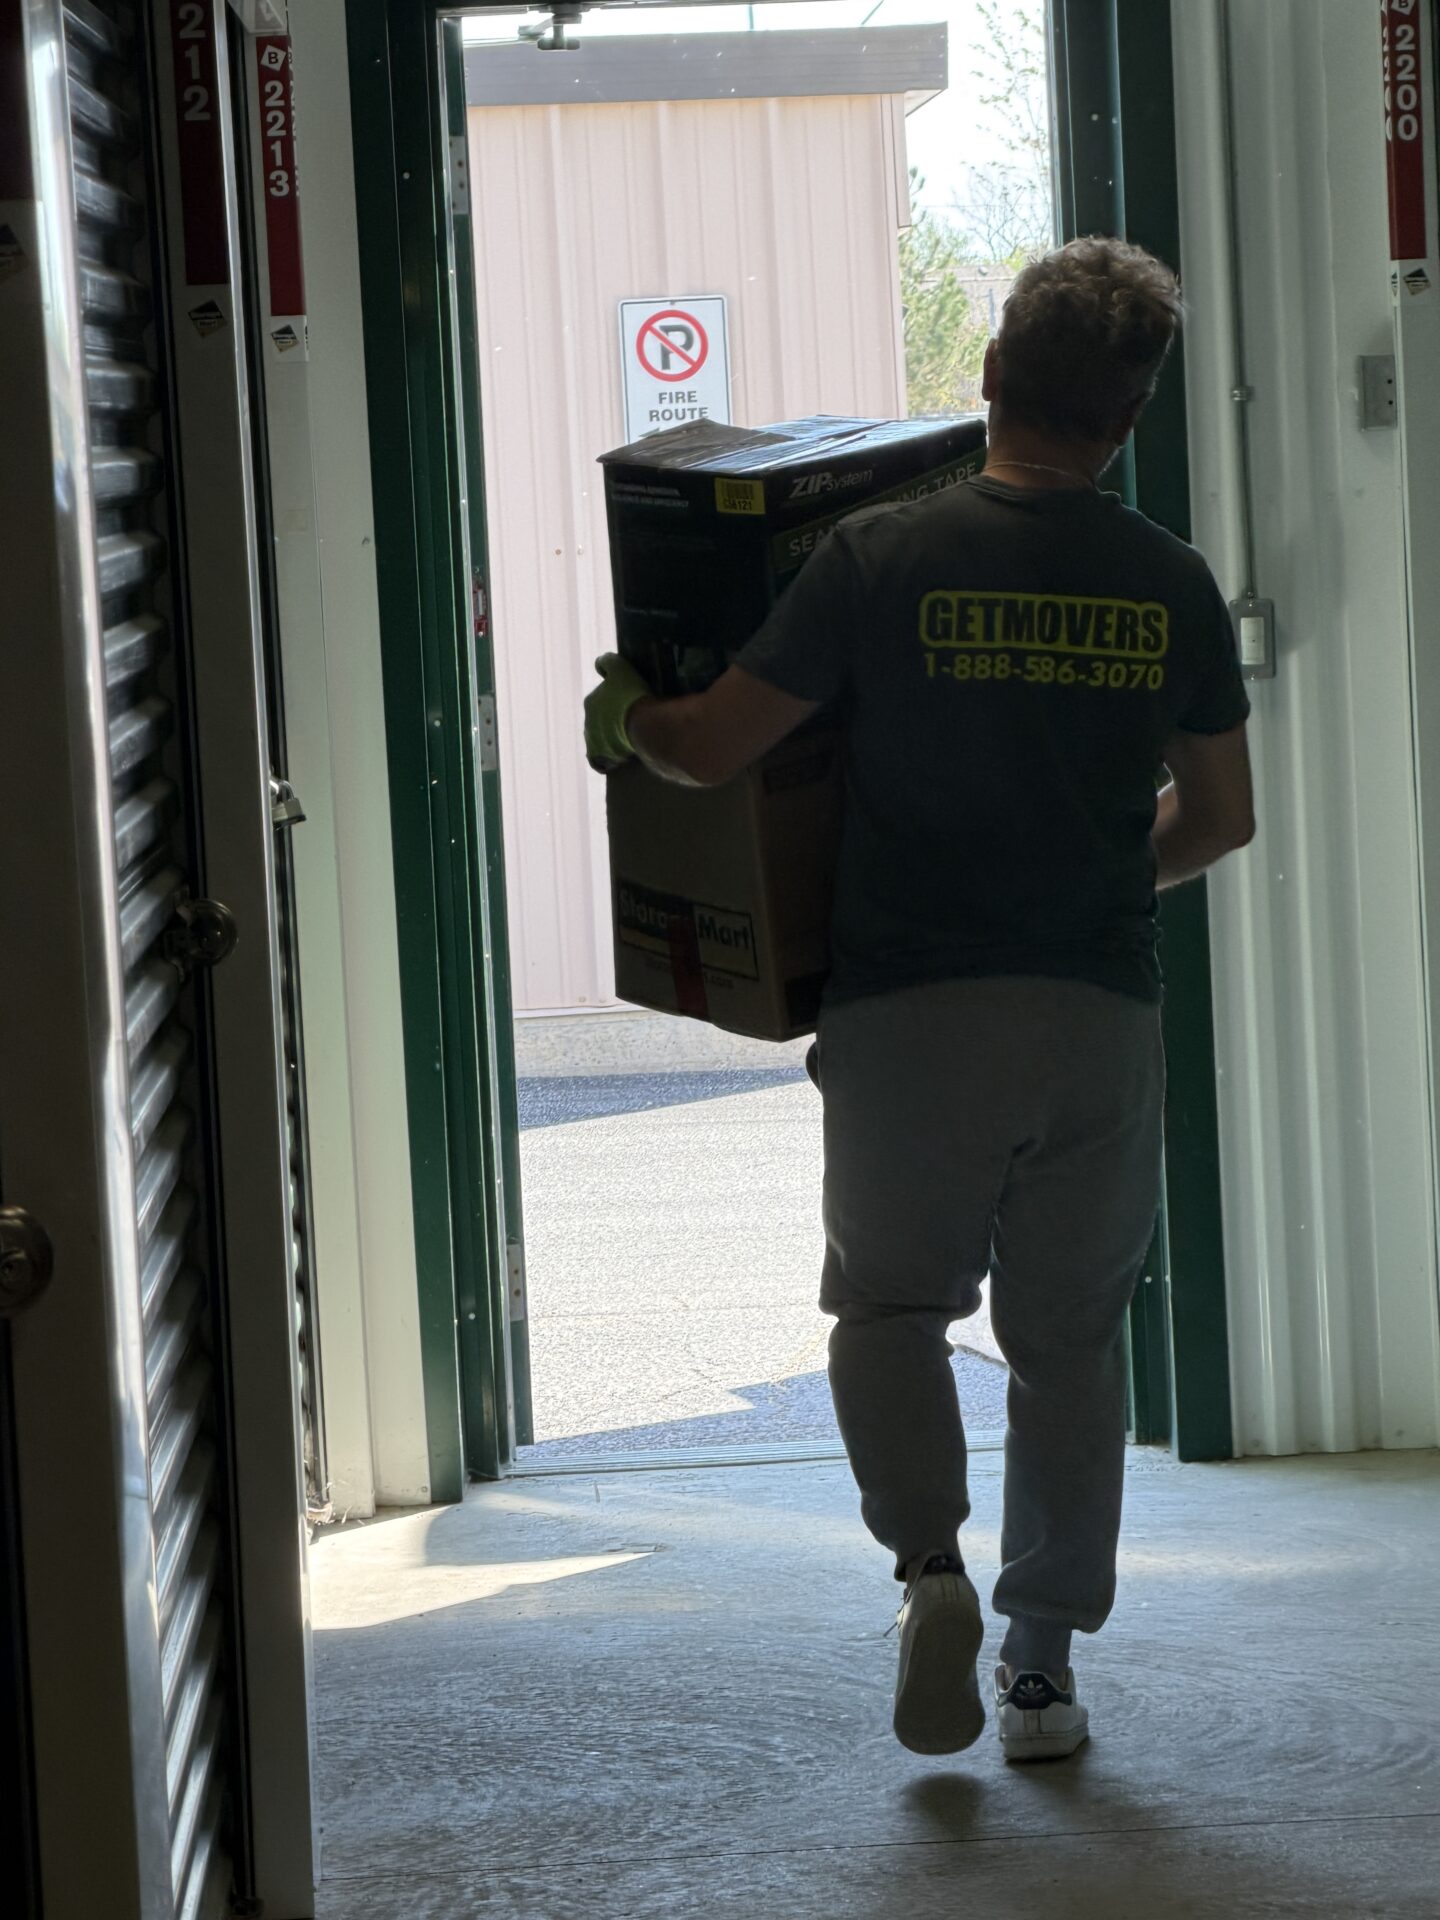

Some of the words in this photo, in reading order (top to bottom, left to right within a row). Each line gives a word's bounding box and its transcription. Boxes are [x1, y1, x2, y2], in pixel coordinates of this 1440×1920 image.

[267, 51, 279, 65] B
[1395, 24, 1418, 141] 2200
[264, 79, 290, 197] 2213
[658, 390, 698, 405] FIRE
[648, 406, 709, 422] ROUTE
[788, 471, 833, 499] ZIP
[933, 462, 976, 490] TAPE
[924, 652, 1165, 690] 1-888-586-3070
[698, 913, 750, 950] Mart
